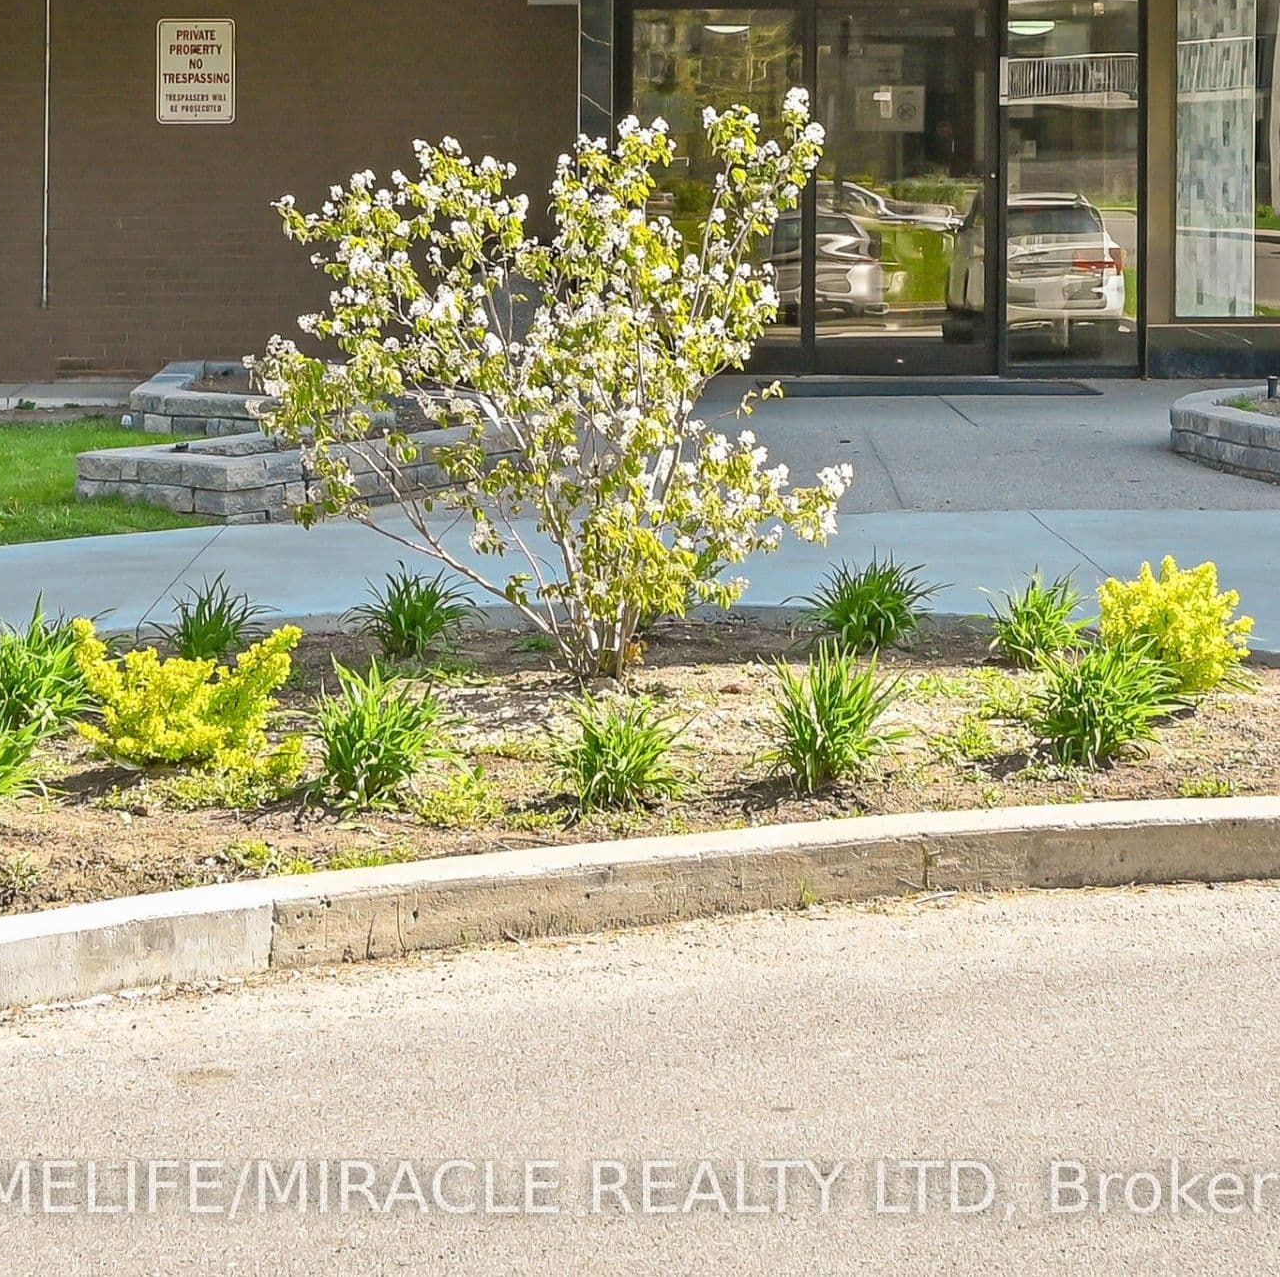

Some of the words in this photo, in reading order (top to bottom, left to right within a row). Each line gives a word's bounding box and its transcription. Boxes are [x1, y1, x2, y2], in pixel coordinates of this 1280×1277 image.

[176, 29, 216, 41] PRIVATE
[169, 44, 223, 55] PROPERTY
[188, 58, 204, 70] NO
[162, 73, 230, 84] TRESPASSING
[165, 93, 209, 102] TRESPASSERS
[212, 93, 227, 102] WILL
[170, 104, 178, 113] BE
[181, 104, 222, 113] PROSECUTED
